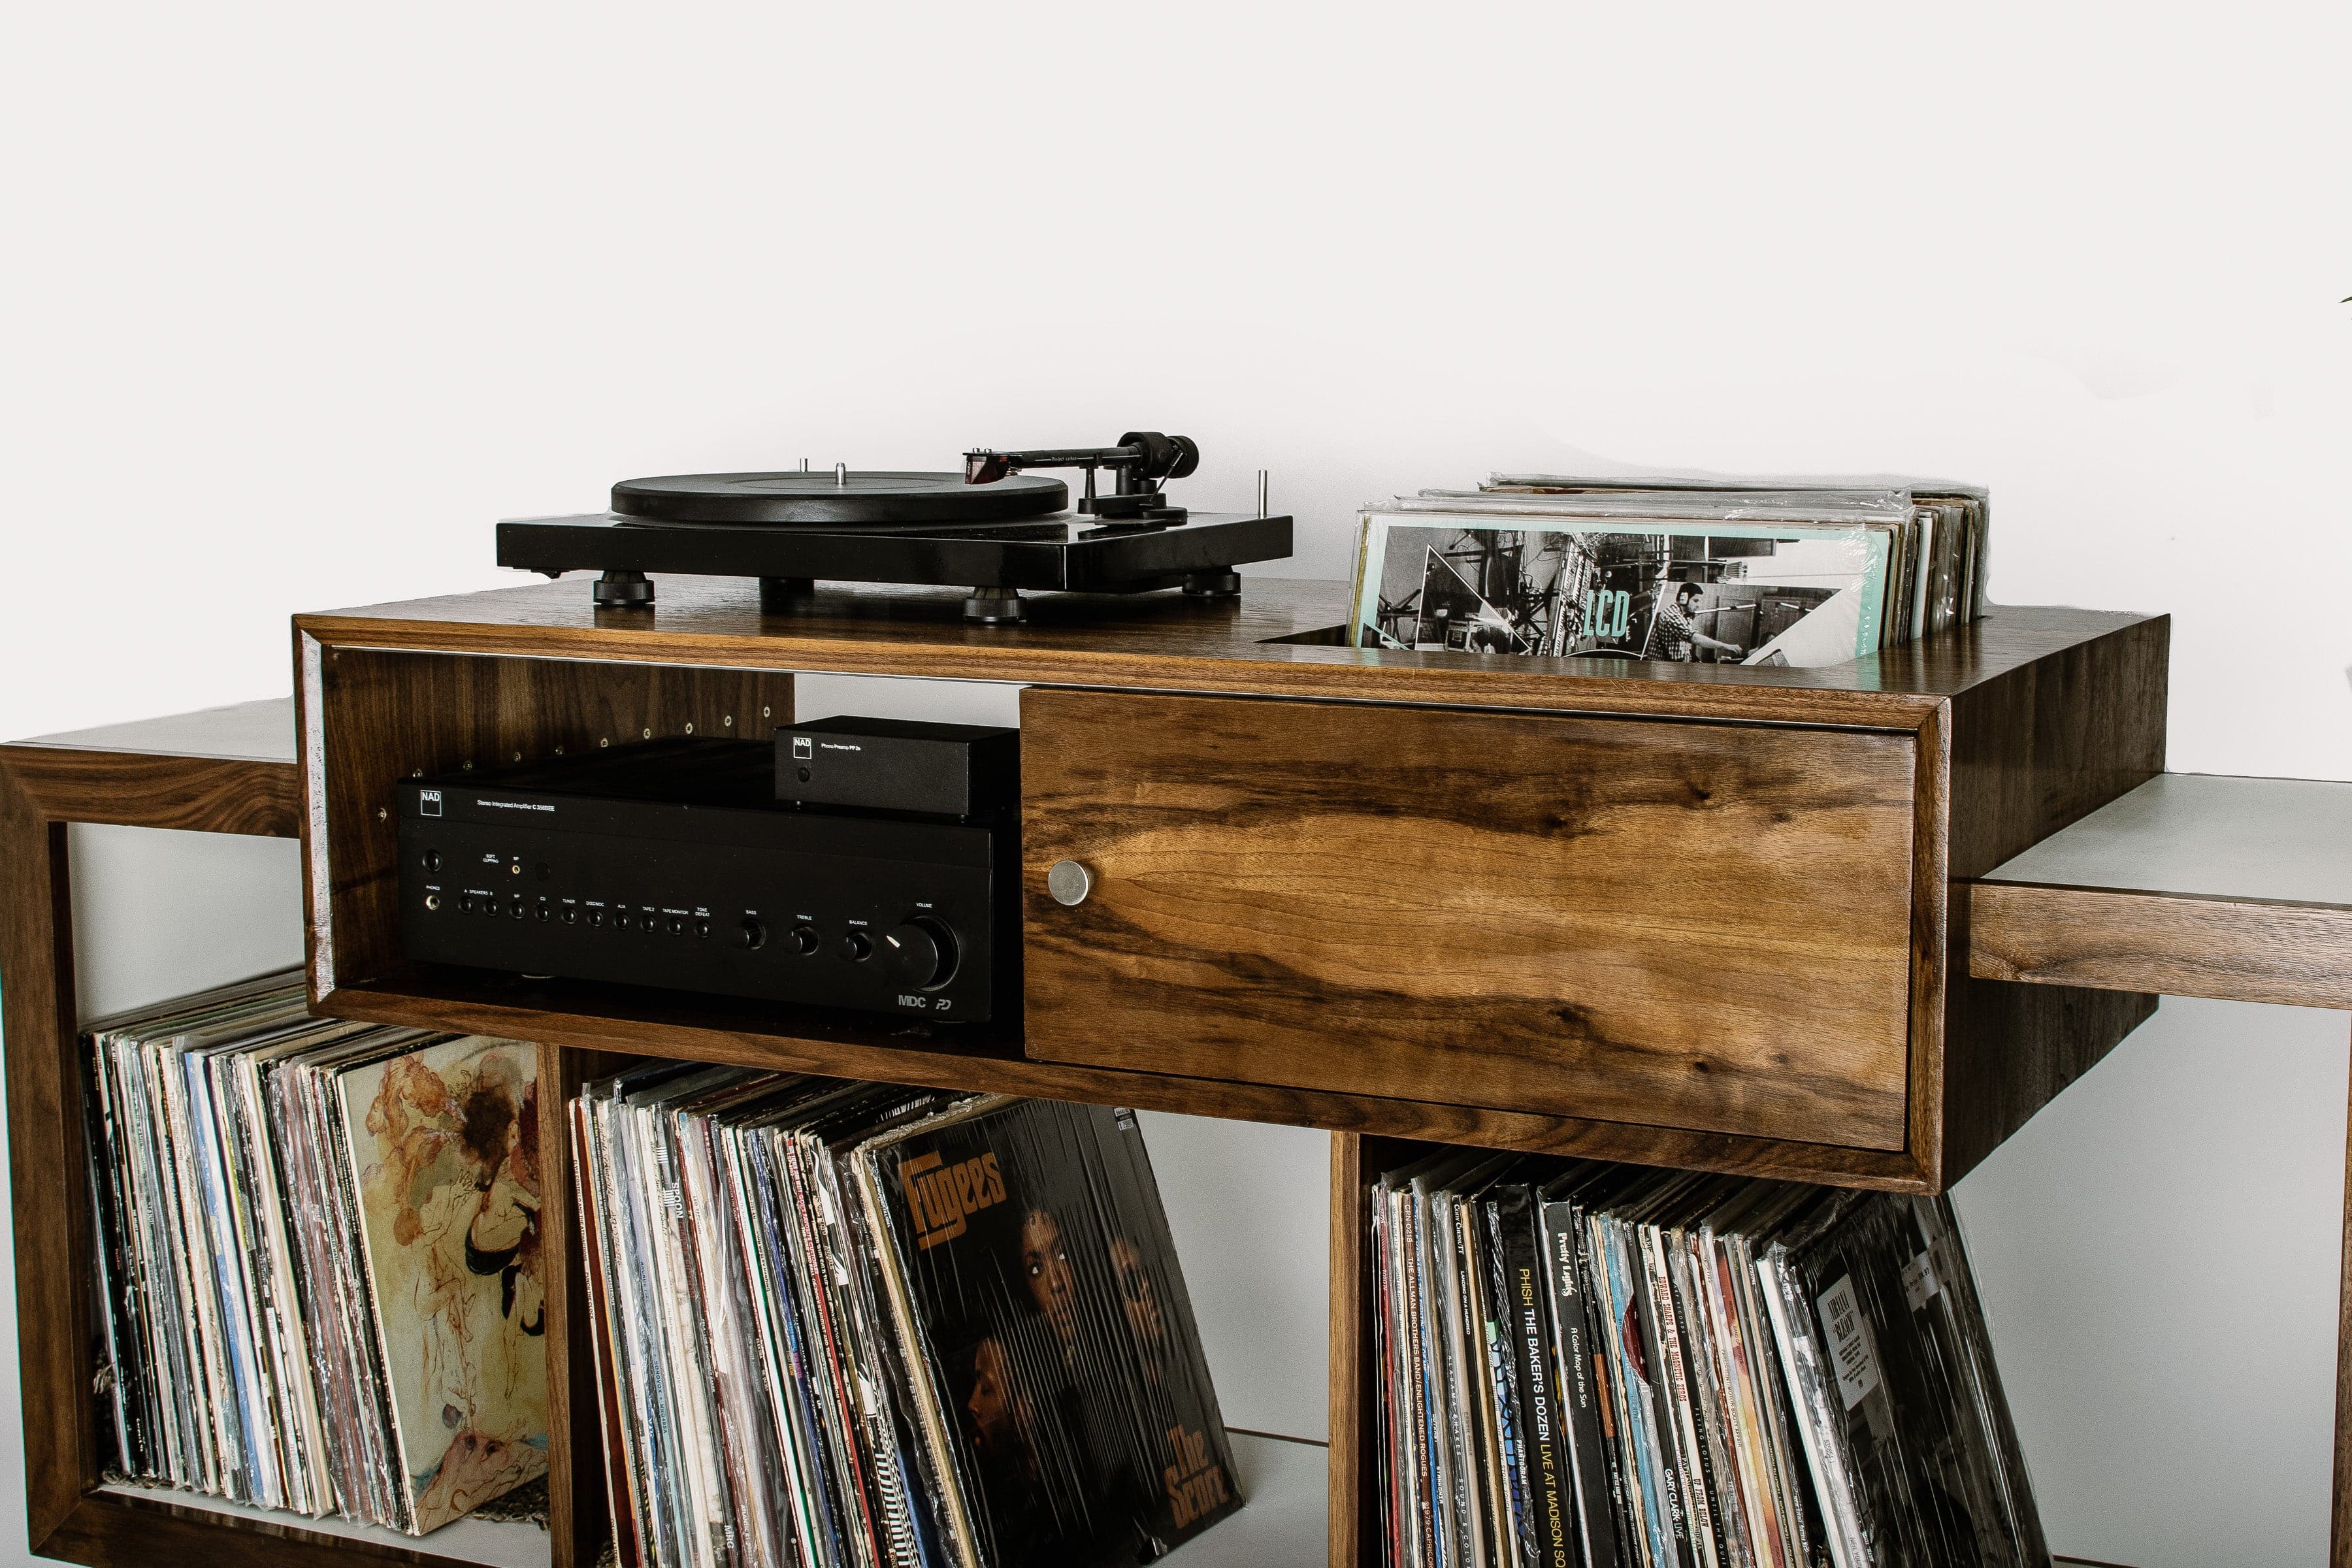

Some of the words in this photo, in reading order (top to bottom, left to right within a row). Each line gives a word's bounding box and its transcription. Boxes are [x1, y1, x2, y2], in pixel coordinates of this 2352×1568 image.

[1582, 589, 1630, 637] LCD
[794, 738, 810, 747] NAD
[422, 792, 440, 802] NAD
[898, 995, 926, 1009] MDC
[671, 1181, 683, 1218] SPOON
[898, 1150, 1006, 1250] Fugees
[802, 1213, 812, 1241] FAVORITE
[1556, 1232, 1570, 1262] Pretty
[1518, 1267, 1533, 1307] PHISH
[1558, 1264, 1577, 1297] Lights
[1658, 1276, 1669, 1301] EDWARD
[1462, 1294, 1467, 1303] ON
[1524, 1309, 1537, 1335] THE
[1663, 1303, 1673, 1326] SHARPE
[1676, 1301, 1685, 1333] RECORDS
[1411, 1311, 1420, 1354] BROTHERS
[1571, 1333, 1580, 1353] Color
[1668, 1336, 1677, 1348] THE
[1527, 1337, 1544, 1394] BAKER'S
[1573, 1353, 1582, 1371] Map
[1671, 1350, 1683, 1381] MAGNETIC
[1447, 1354, 1456, 1406] ALABAMA
[1676, 1383, 1686, 1401] ZEROS
[279, 1382, 289, 1416] COLTRANE
[1414, 1356, 1425, 1441] BAND/ENLIGHTENED
[1578, 1394, 1587, 1407] Sun
[1534, 1396, 1550, 1441] DOZEN
[1165, 1424, 1209, 1478] The
[1516, 1439, 1527, 1484] PHANTOGRAM
[1541, 1443, 1553, 1469] LIVE
[1694, 1407, 1705, 1440] FLYING
[1701, 1445, 1710, 1473] LOTUS
[1708, 1490, 1718, 1516] UNTIL
[1544, 1471, 1556, 1488] AT
[1664, 1467, 1676, 1492] GARY
[1164, 1461, 1229, 1529] Score
[1668, 1492, 1680, 1520] CLARK
[1694, 1488, 1704, 1505] FROM
[740, 1504, 749, 1531] ATLANTIC
[1546, 1489, 1563, 1547] MADISON
[1697, 1507, 1708, 1527] BELOW
[723, 1524, 734, 1548] MRG
[1673, 1522, 1683, 1540] LIVE
[1849, 1536, 1857, 1550] NEIL
[1554, 1549, 1565, 1568] SQ
